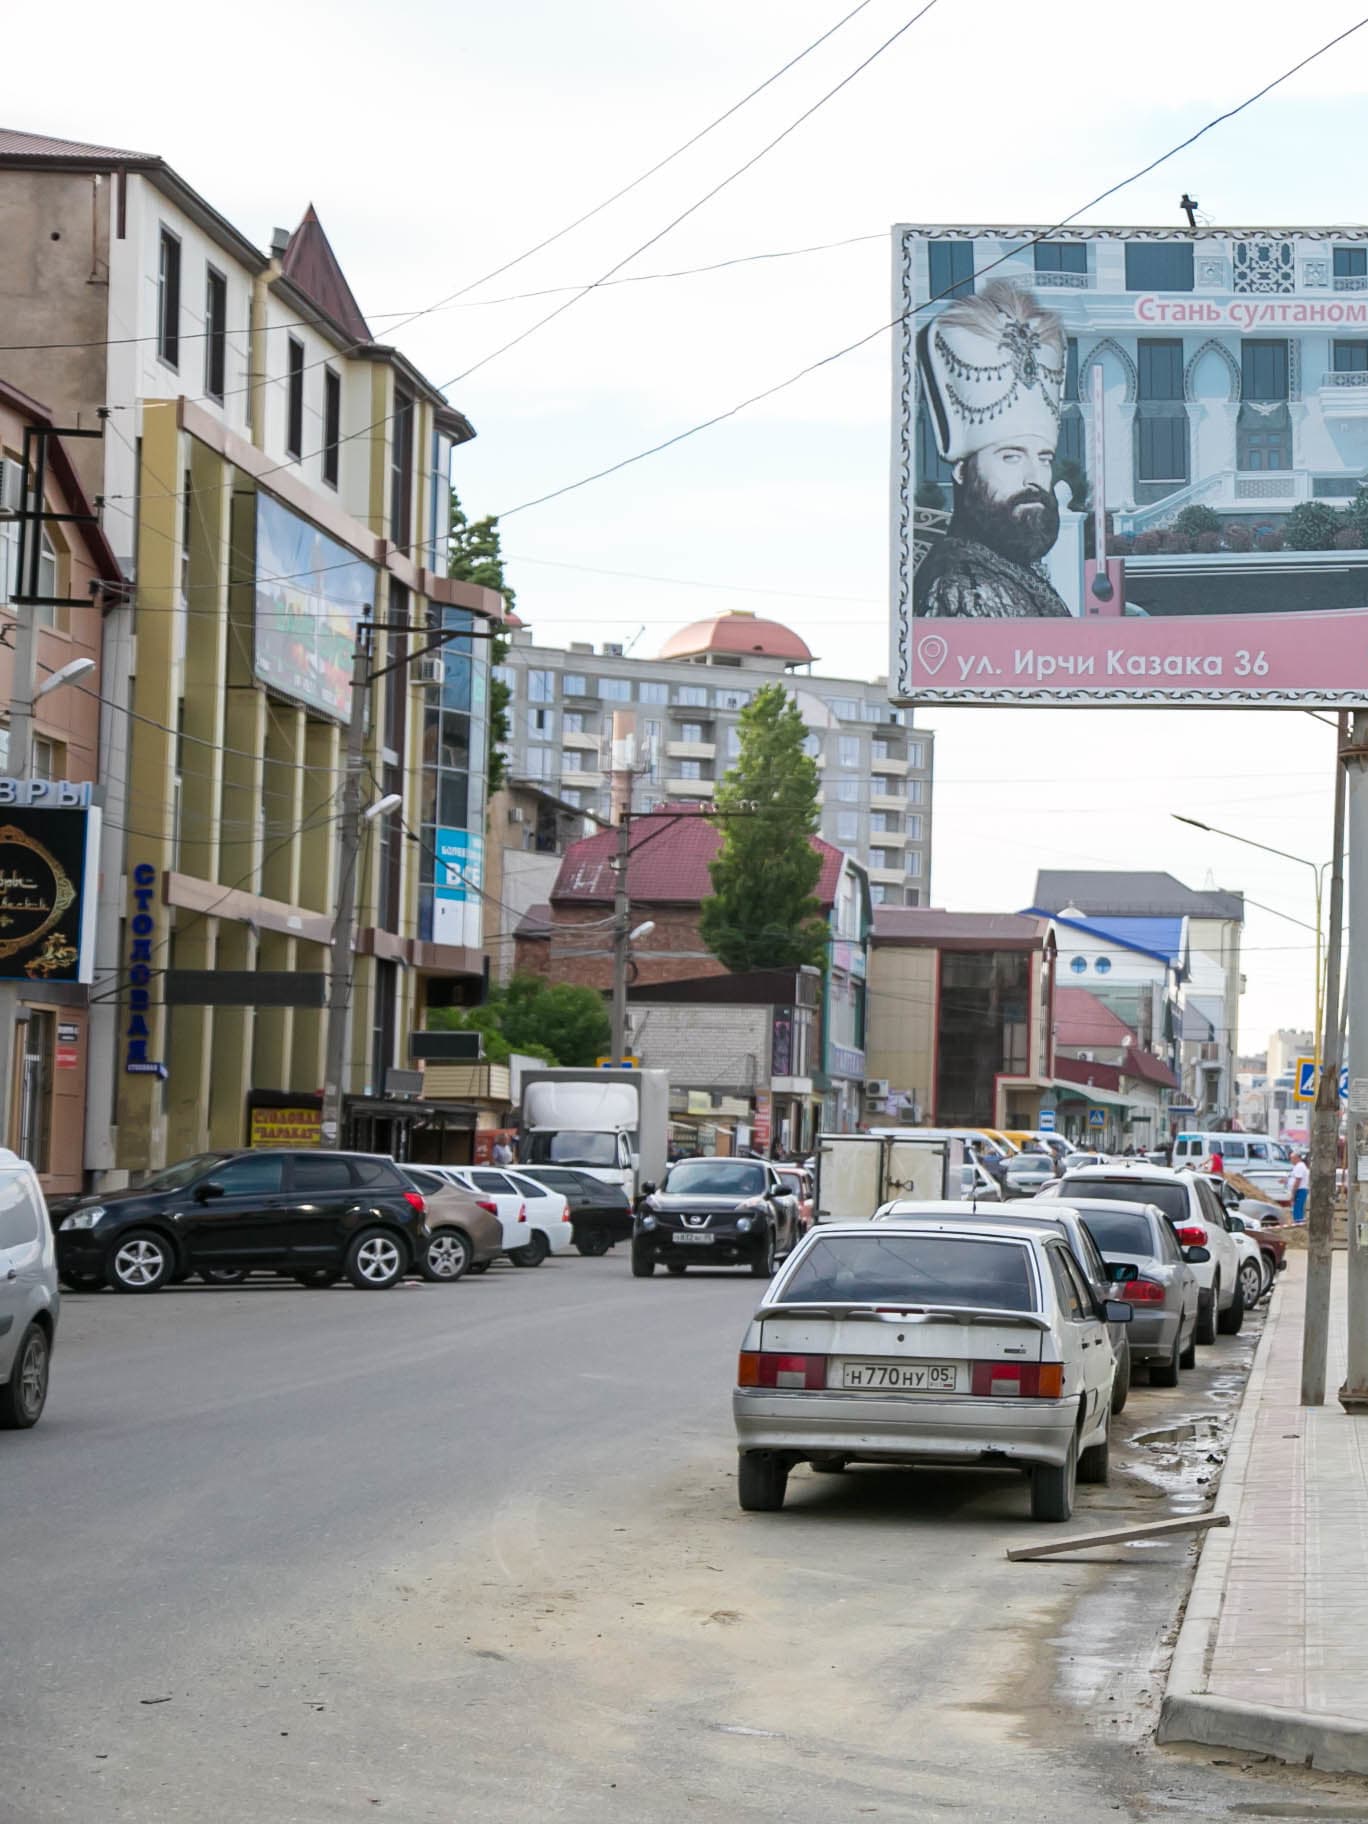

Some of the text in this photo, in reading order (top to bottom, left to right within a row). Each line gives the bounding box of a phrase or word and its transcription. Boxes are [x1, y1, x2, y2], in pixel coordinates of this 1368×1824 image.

[1138, 297, 1221, 322] Стань
[1228, 302, 1366, 329] султаном
[956, 650, 1270, 680] ул. Ирчи Казака 36
[127, 863, 156, 1062] СТОЛОВАЯ
